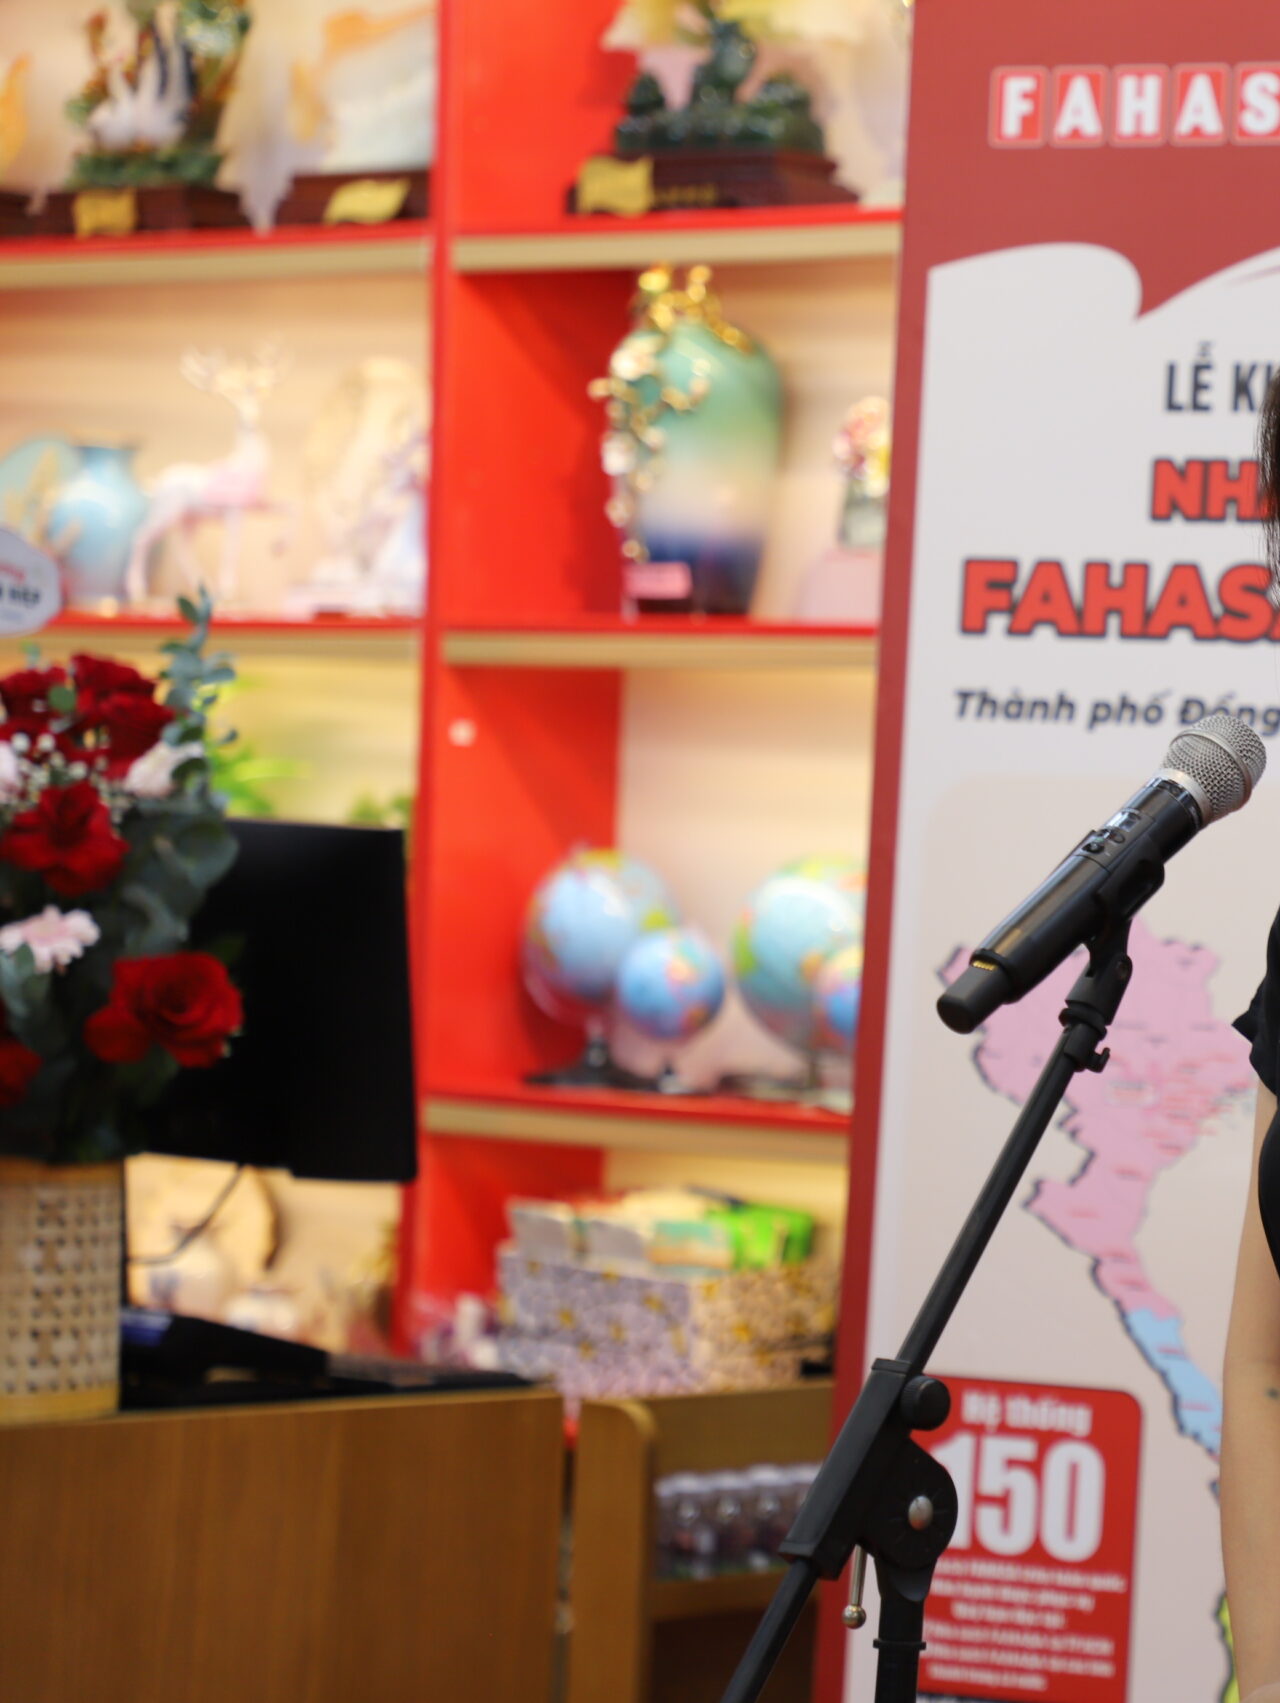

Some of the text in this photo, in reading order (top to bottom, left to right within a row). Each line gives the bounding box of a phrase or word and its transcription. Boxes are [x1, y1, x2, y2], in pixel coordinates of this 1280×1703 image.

[1166, 340, 1213, 412] LỄ
[1150, 456, 1276, 522] NH
[954, 688, 1077, 721] Thành
[1086, 688, 1173, 731] phố
[929, 1431, 1106, 1563] 150
